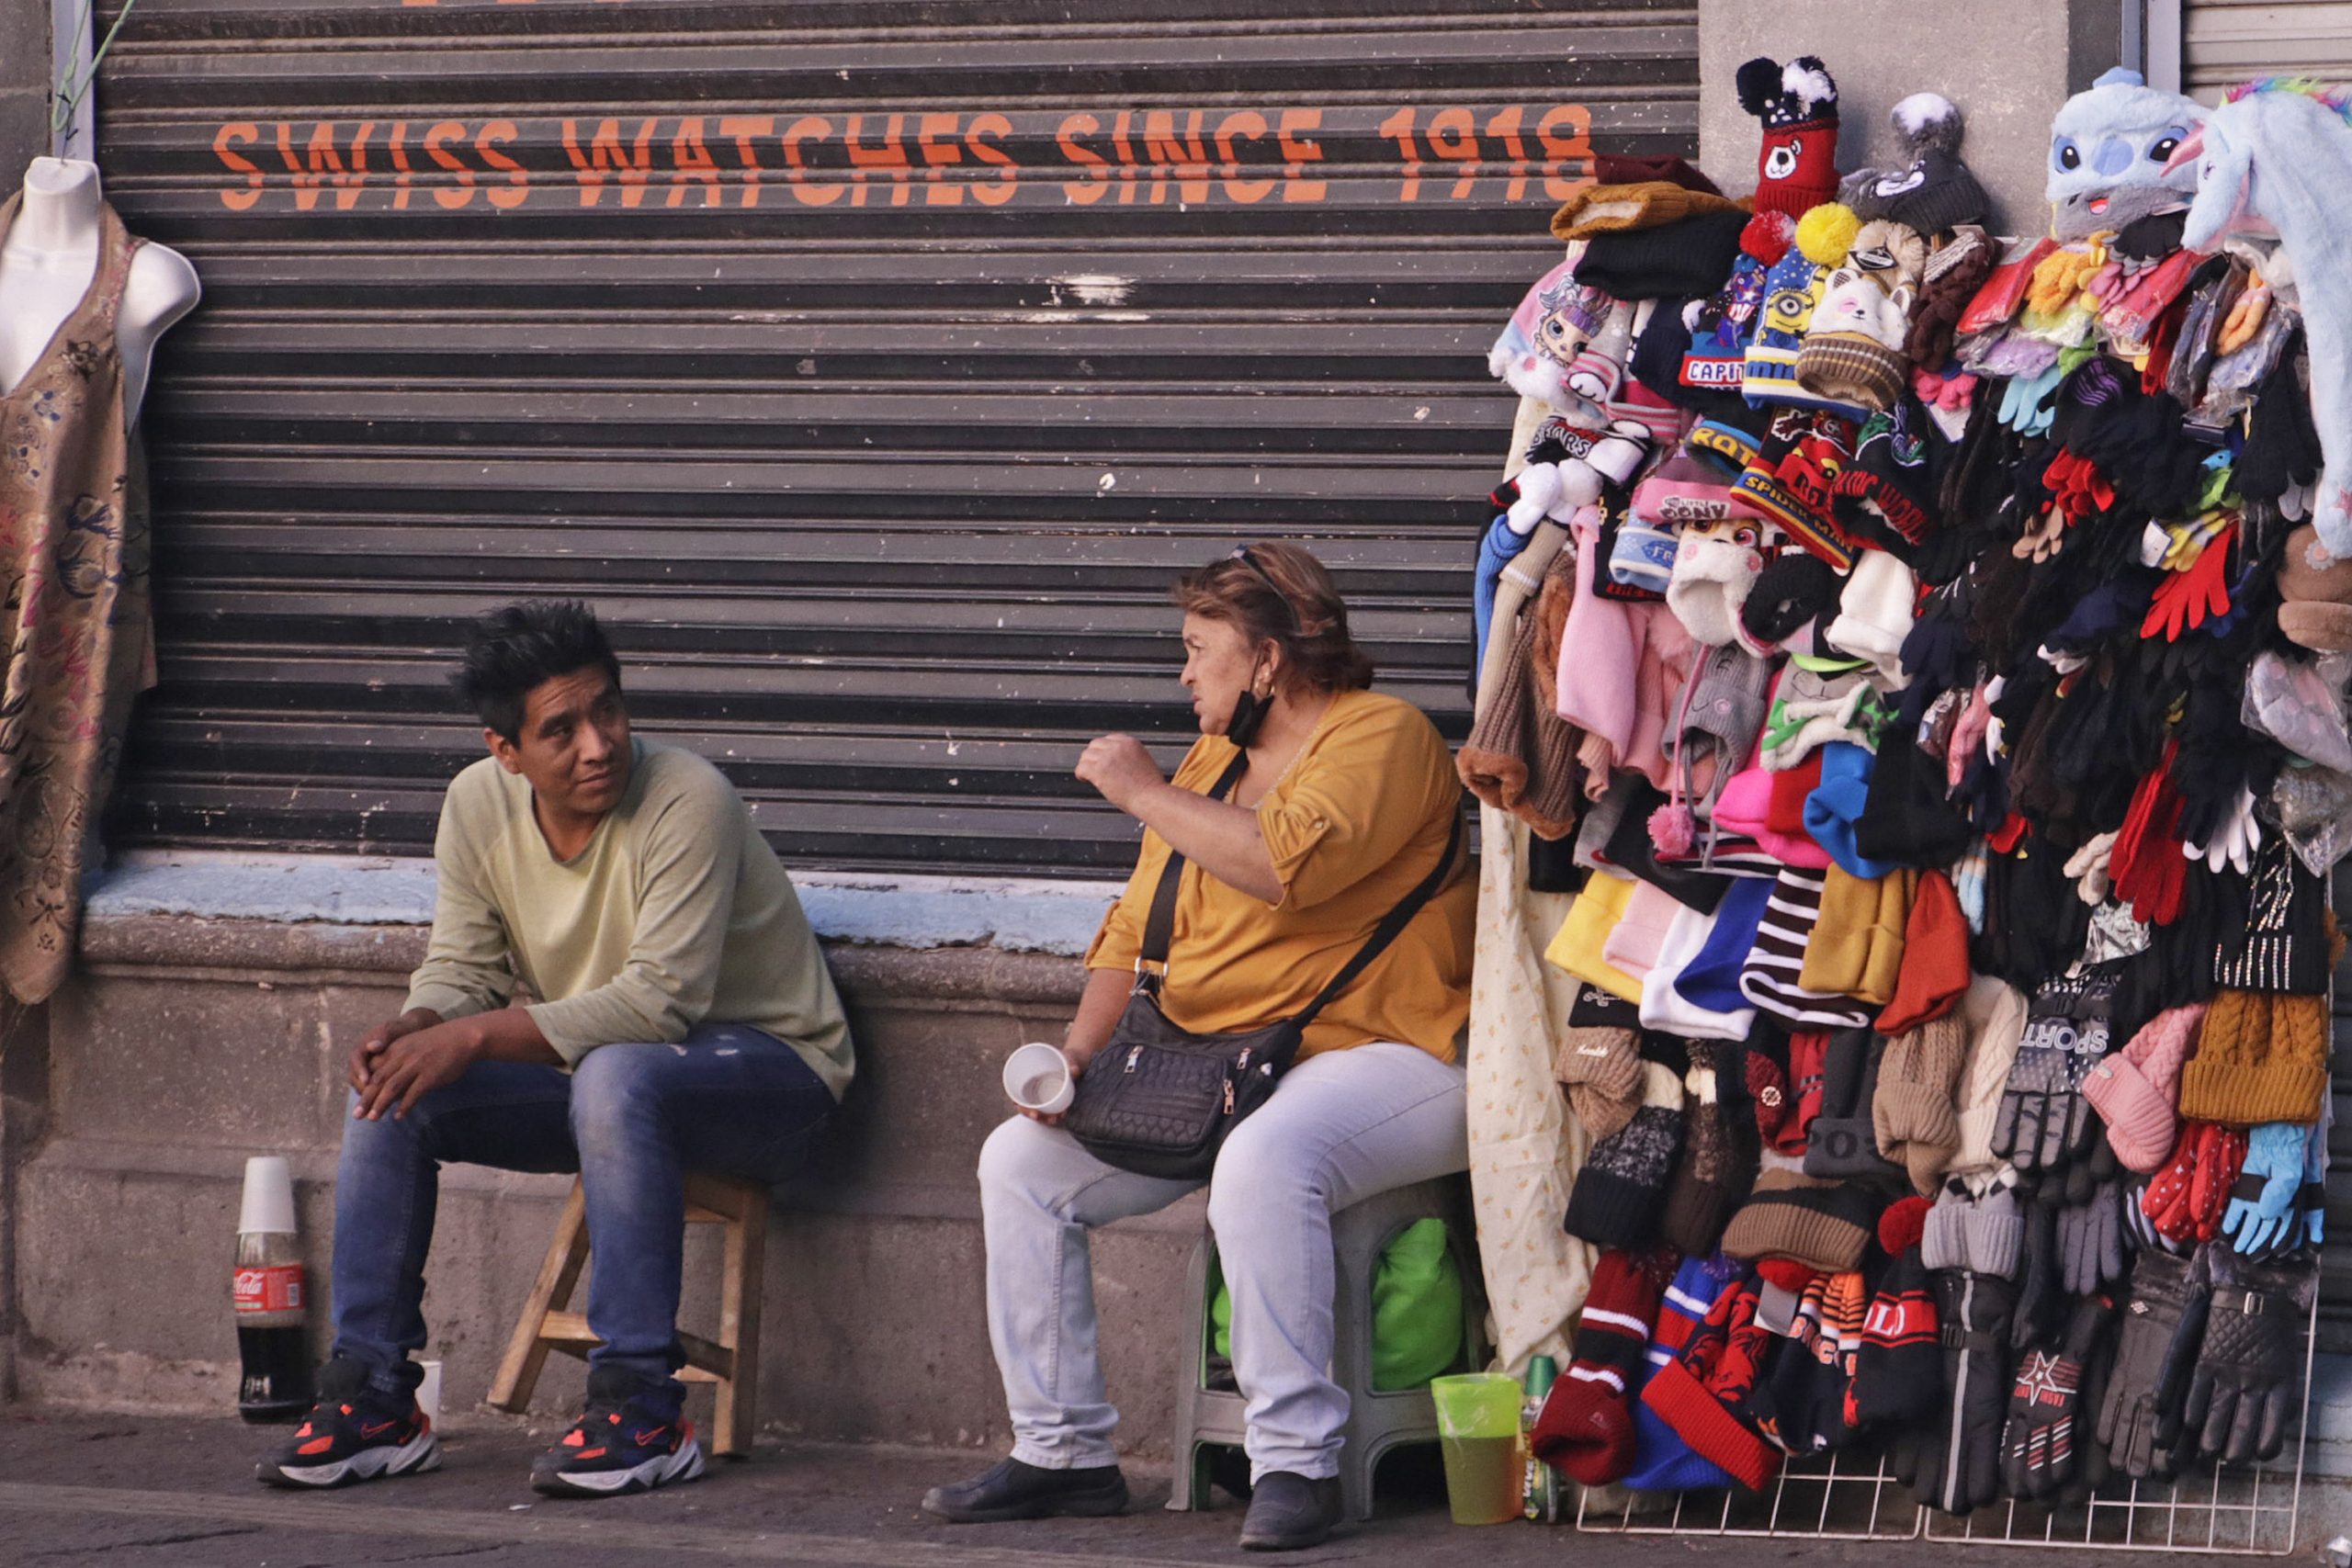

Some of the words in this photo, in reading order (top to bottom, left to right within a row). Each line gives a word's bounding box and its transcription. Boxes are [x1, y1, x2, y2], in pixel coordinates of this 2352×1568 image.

[212, 120, 530, 211] SWISS
[561, 113, 1019, 208] WATCHES
[1055, 107, 1329, 205] SINCE
[1379, 104, 1598, 202] 1918
[2018, 1023, 2109, 1055] SPORT
